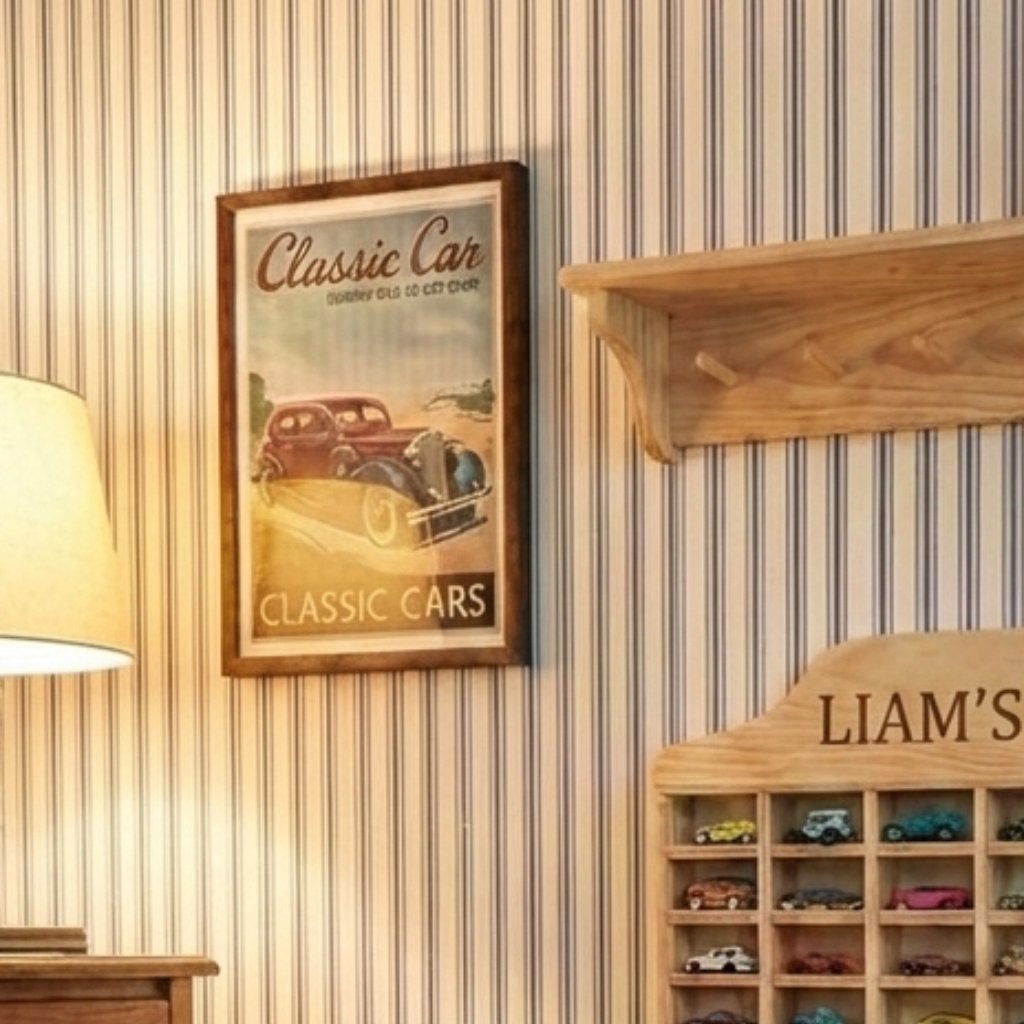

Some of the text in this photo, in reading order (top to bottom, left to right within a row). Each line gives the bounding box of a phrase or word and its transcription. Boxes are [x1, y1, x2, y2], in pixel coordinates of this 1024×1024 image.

[257, 232, 400, 293] Classic
[410, 215, 486, 276] Car
[260, 583, 486, 626] CLASSIC CARS
[819, 687, 1022, 745] LIAM’S
